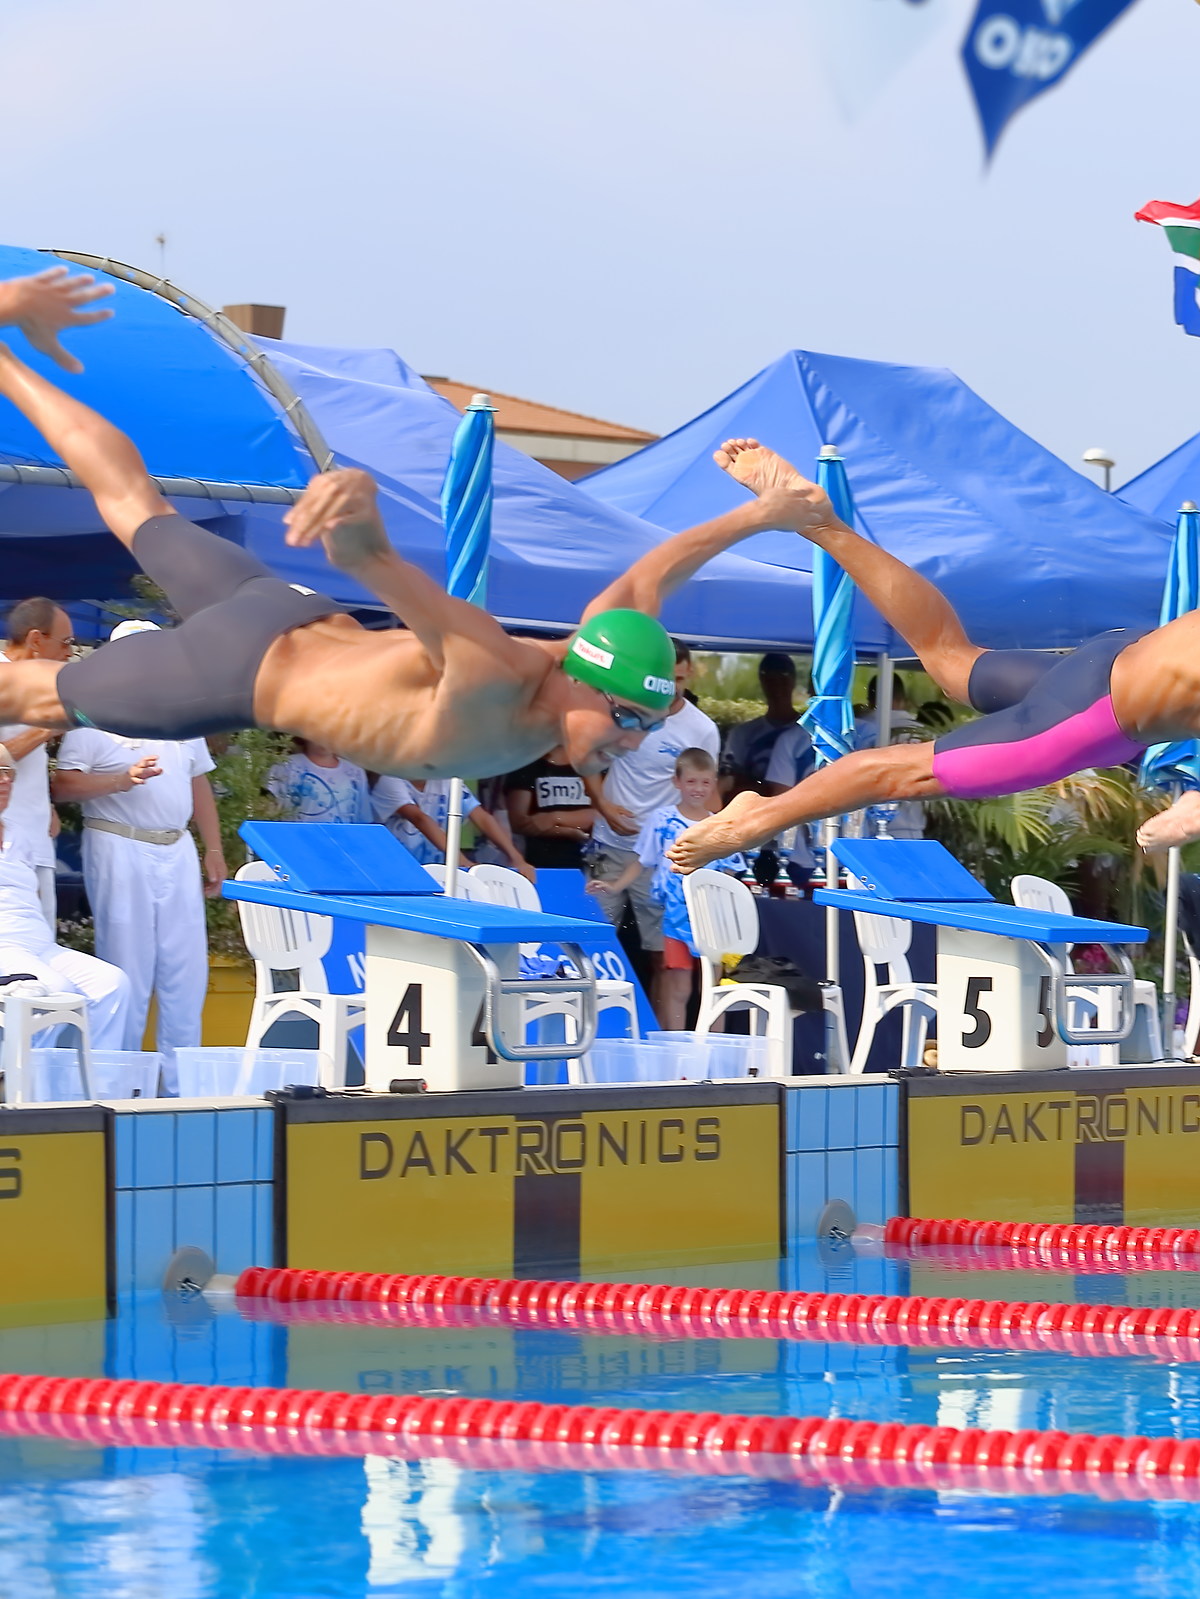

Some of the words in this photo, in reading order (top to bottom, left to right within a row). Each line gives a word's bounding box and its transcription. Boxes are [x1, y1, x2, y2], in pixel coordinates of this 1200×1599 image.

[643, 675, 676, 696] aren
[387, 983, 431, 1065] 4
[961, 976, 993, 1048] 5
[359, 1116, 721, 1181] DAKTRONICS
